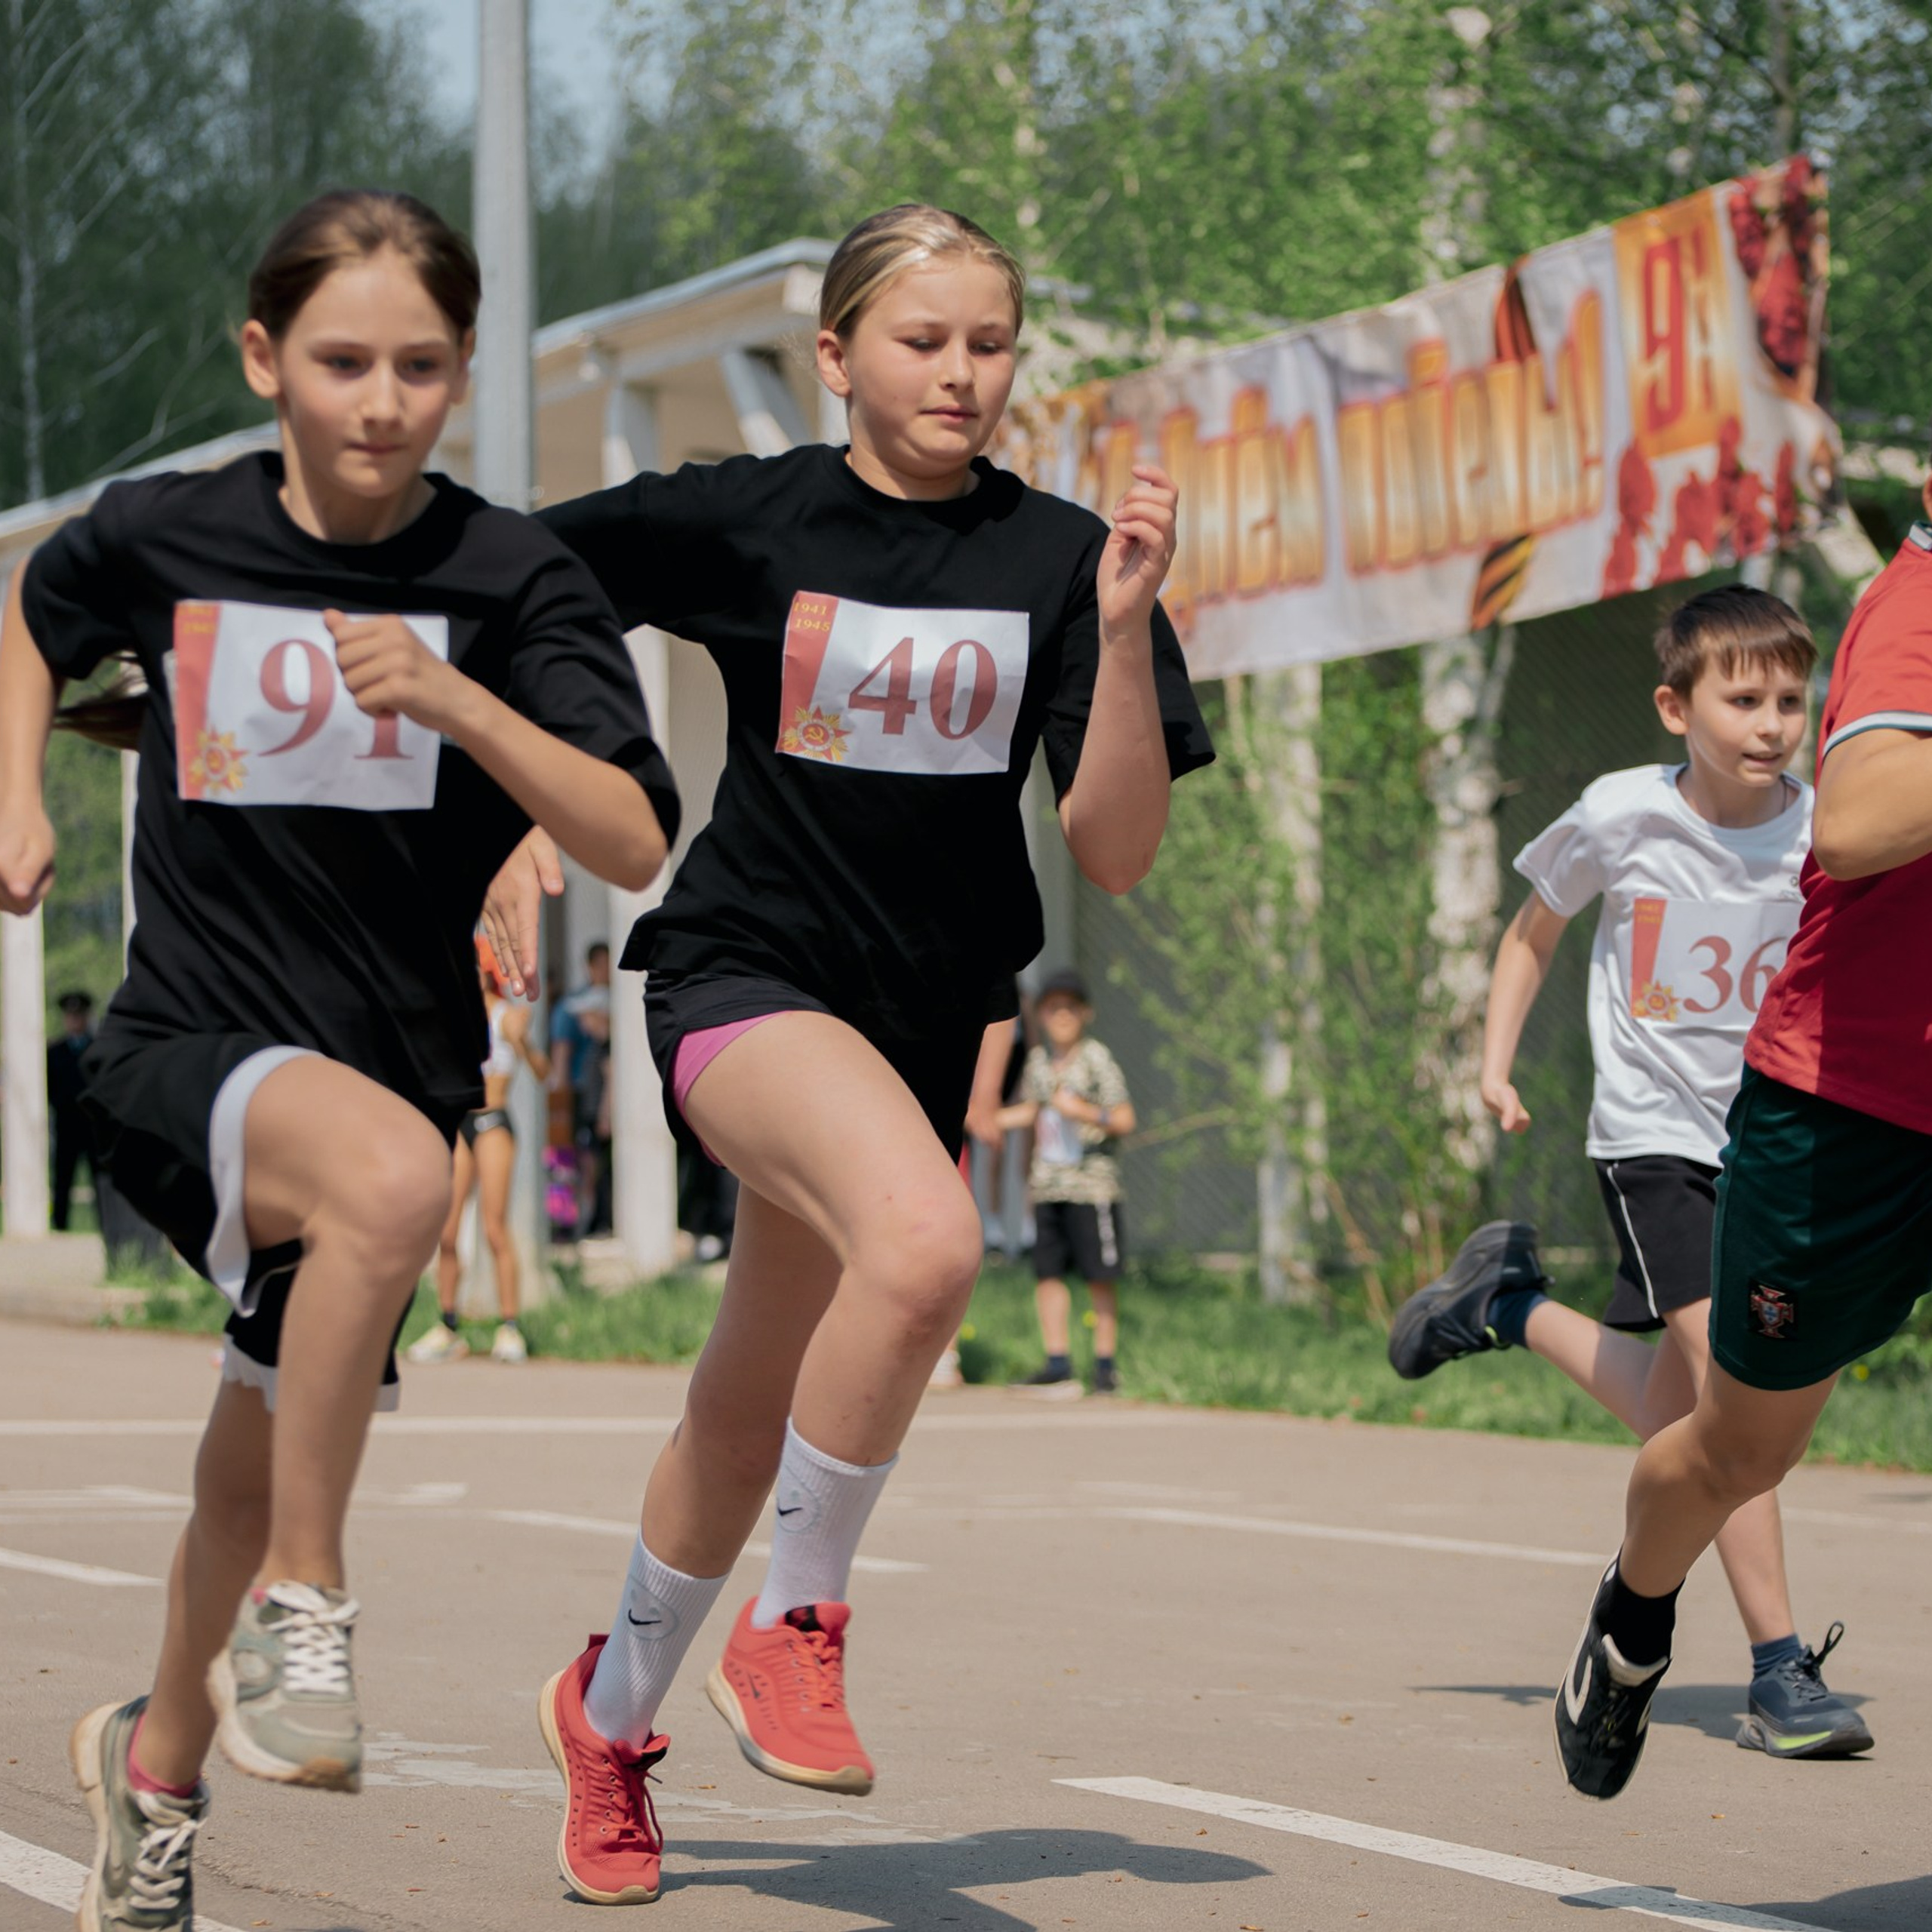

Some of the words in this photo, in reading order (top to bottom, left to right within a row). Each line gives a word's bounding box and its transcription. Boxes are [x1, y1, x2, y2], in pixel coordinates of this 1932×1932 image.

[793, 601, 827, 616] 1941
[795, 618, 831, 632] 1945
[848, 636, 998, 740] 40
